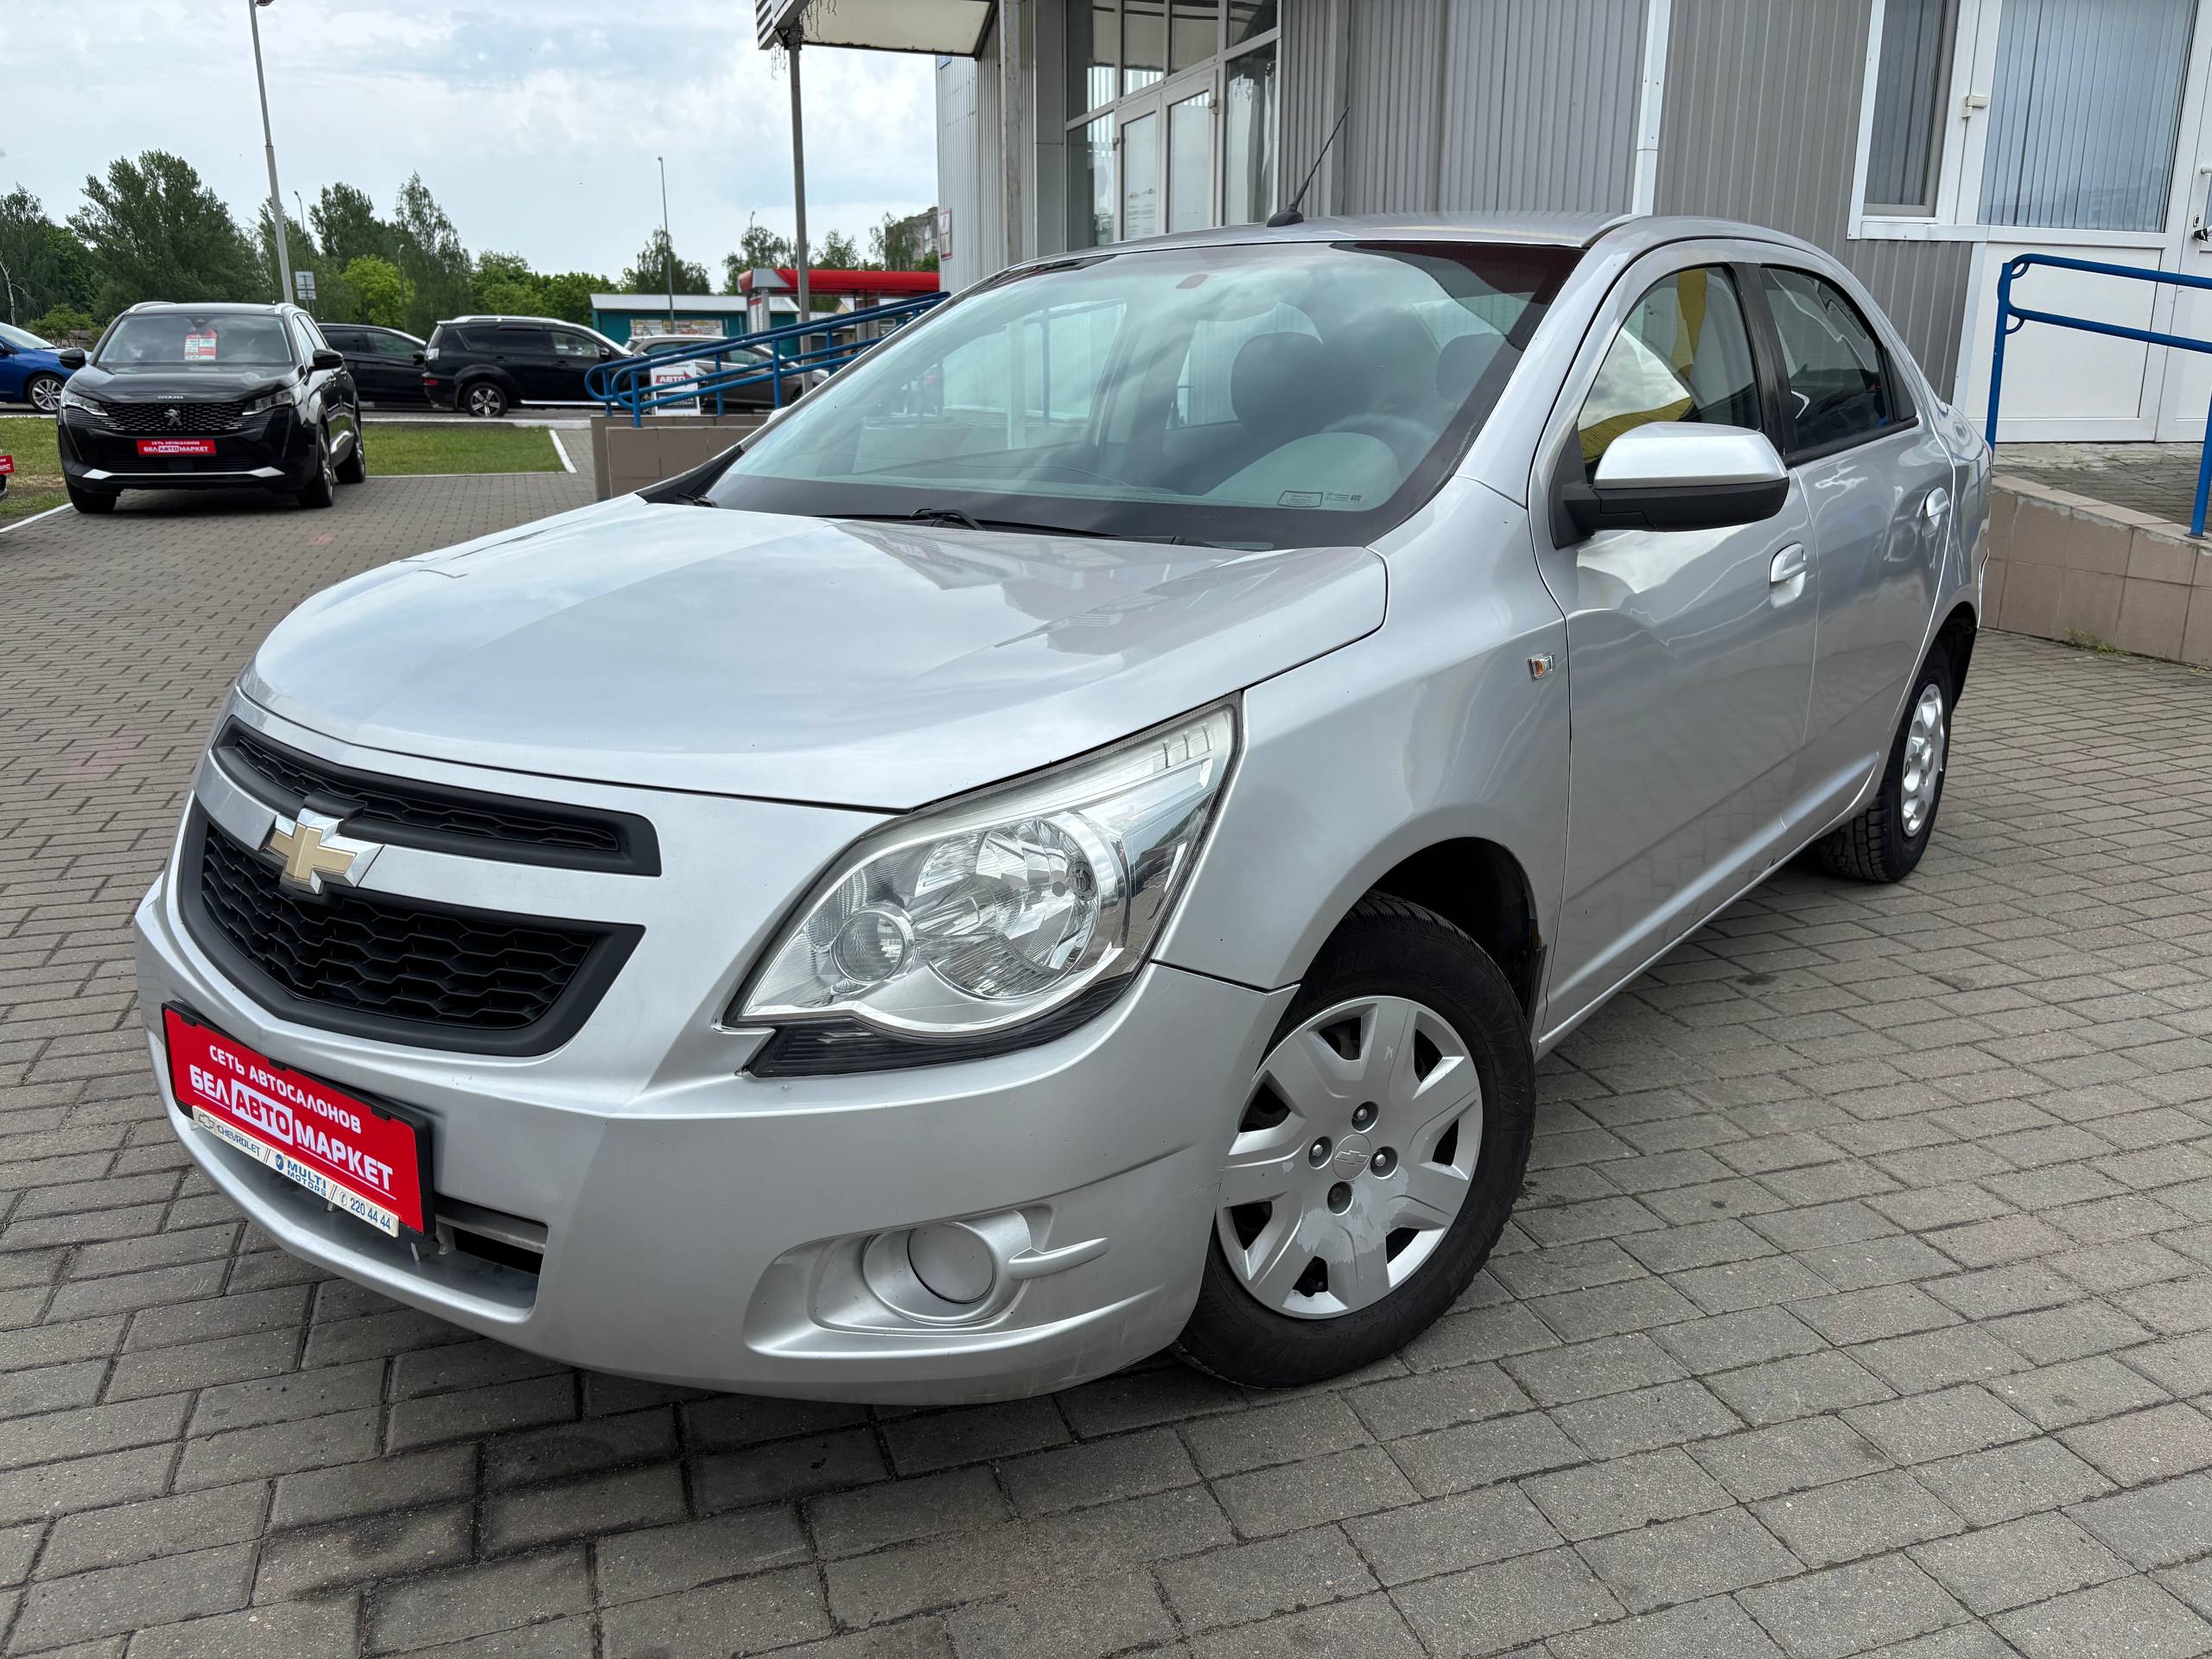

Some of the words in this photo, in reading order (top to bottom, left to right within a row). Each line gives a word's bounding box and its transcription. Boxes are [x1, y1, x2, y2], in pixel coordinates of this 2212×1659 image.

[209, 1045, 245, 1076] СЕТЬ
[250, 1065, 362, 1135] АВТОСАЛОНОВ
[217, 1125, 260, 1157] CHEVROLET
[288, 1160, 327, 1189] MULTI
[288, 1170, 327, 1197] MOTORS
[350, 1198, 365, 1216] 220
[367, 1206, 378, 1223] 44
[380, 1212, 391, 1230] 44
